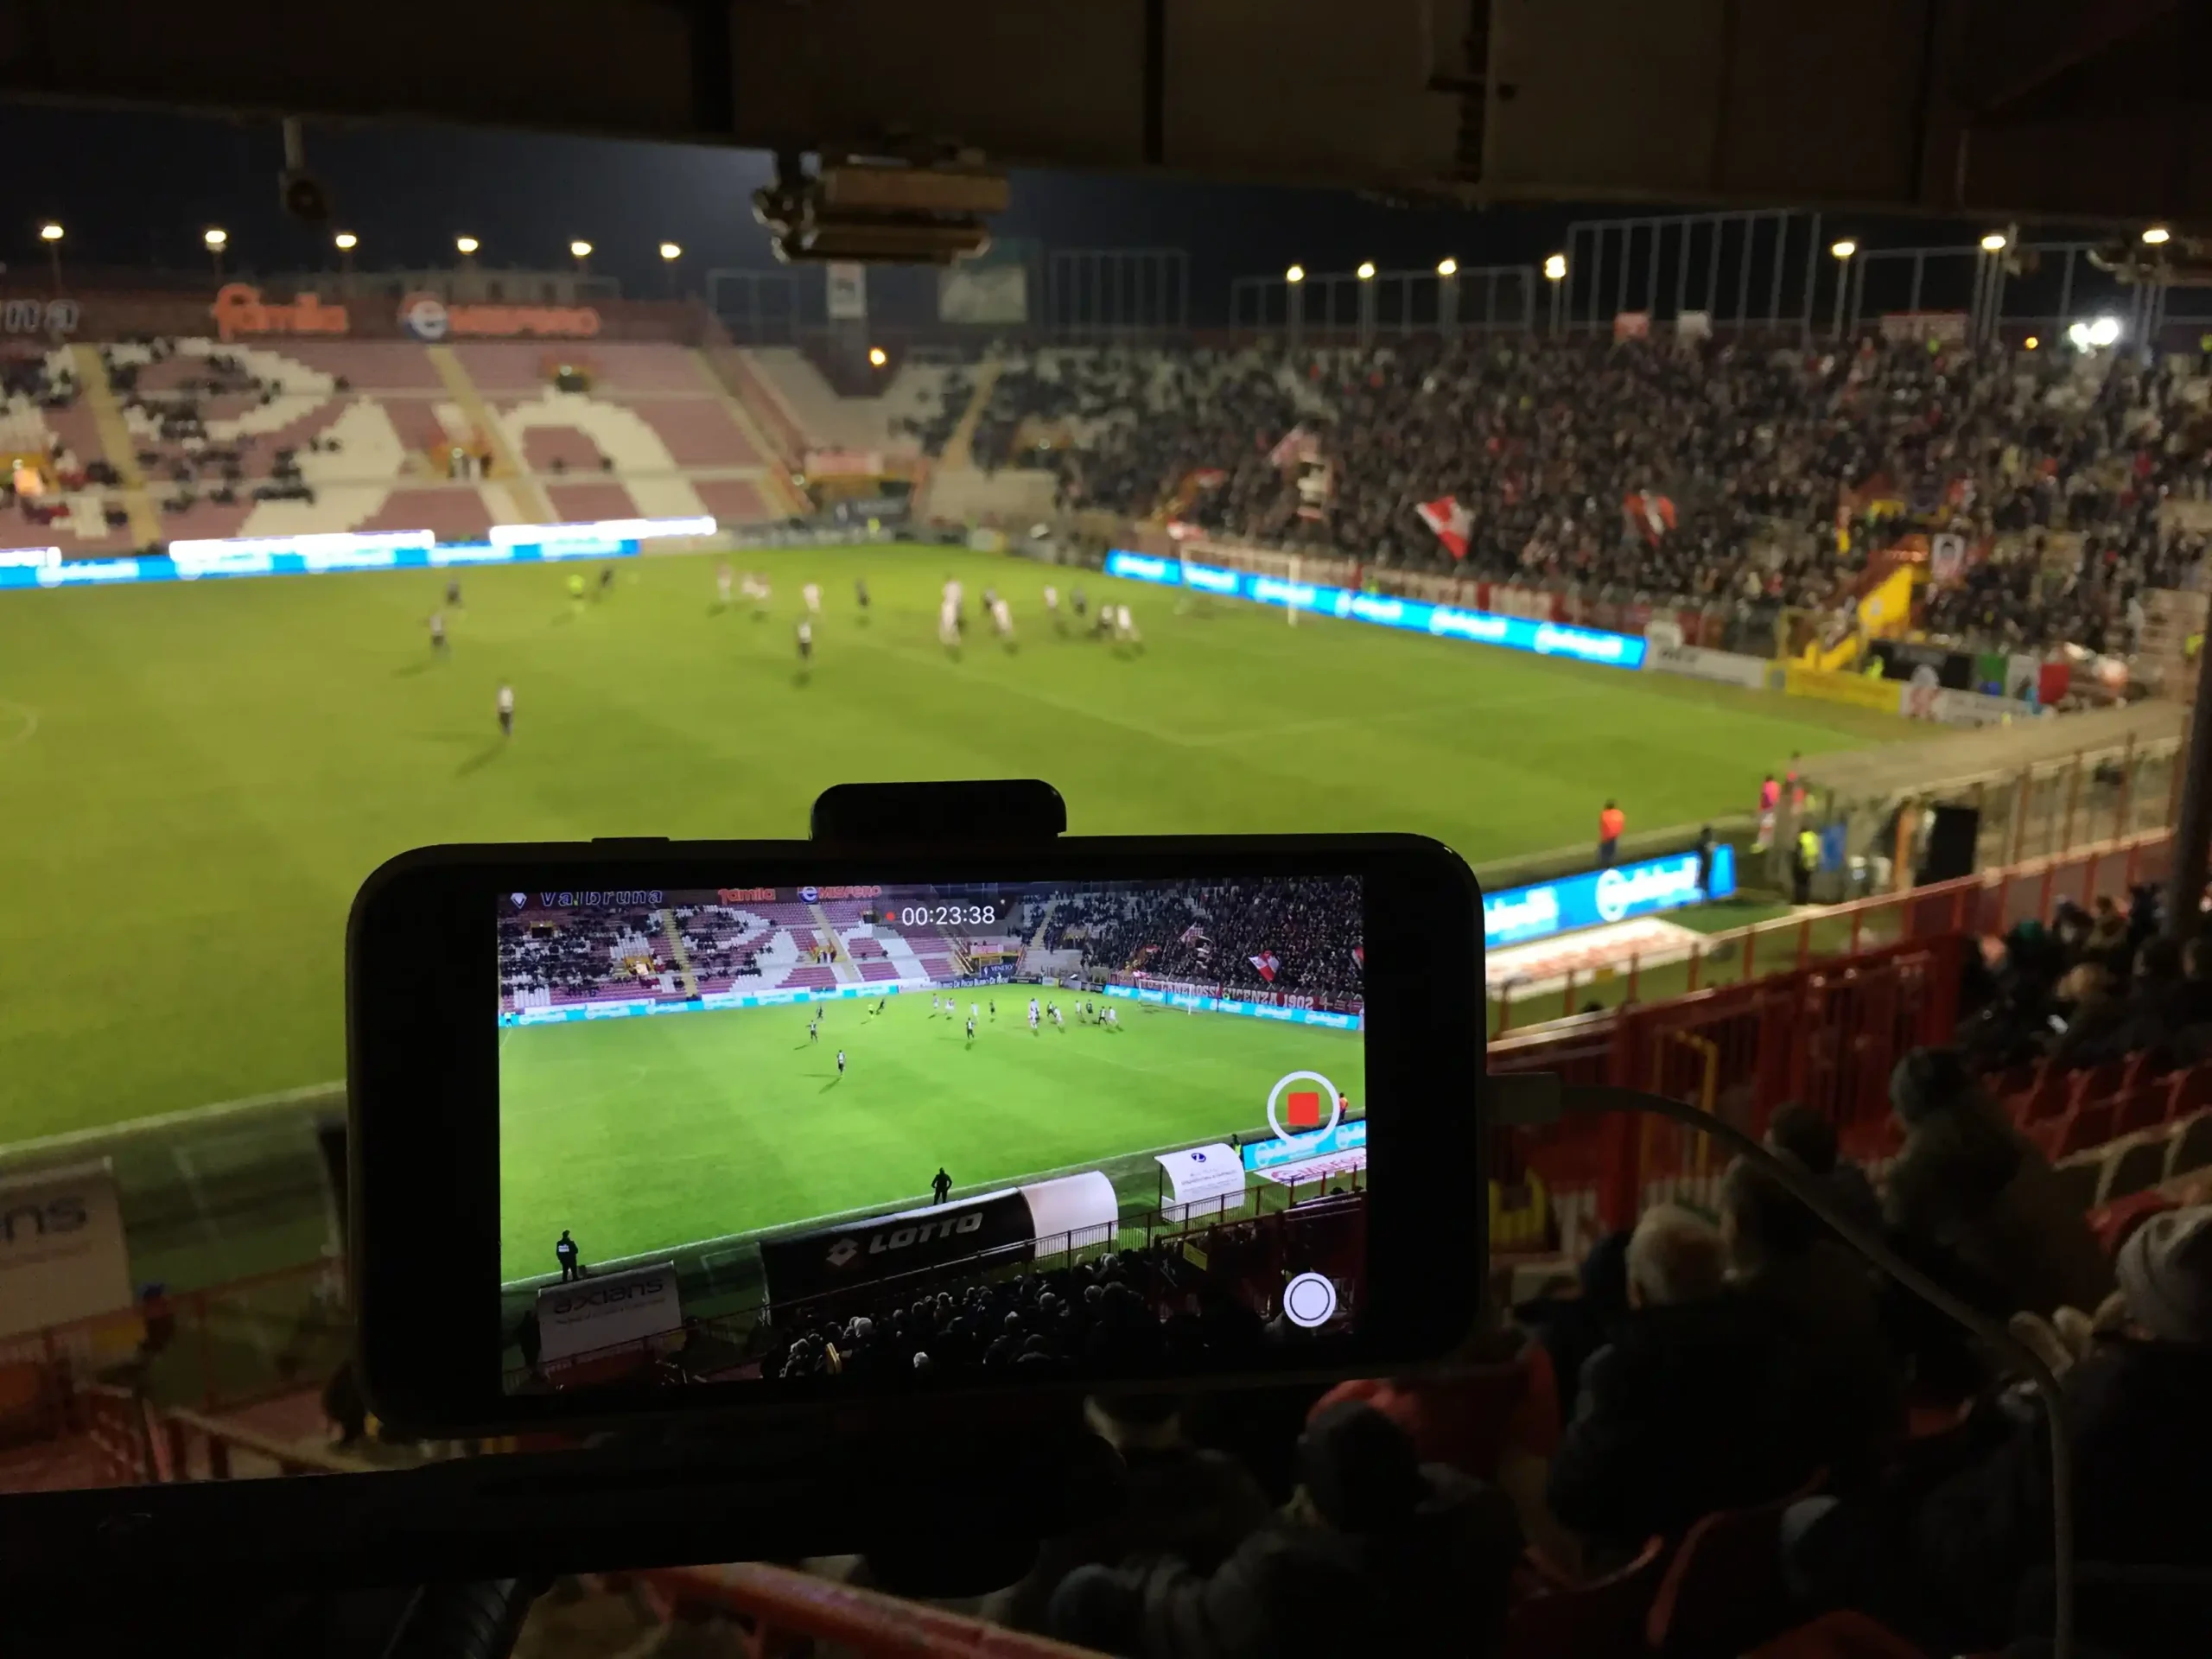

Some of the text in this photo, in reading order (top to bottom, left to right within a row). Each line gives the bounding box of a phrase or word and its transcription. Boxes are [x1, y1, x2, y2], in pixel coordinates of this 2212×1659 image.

[902, 906, 995, 925] 00:23:38
[1282, 994, 1314, 1010] 1902
[869, 1212, 983, 1254] LOTTO
[553, 1279, 664, 1314] axians
